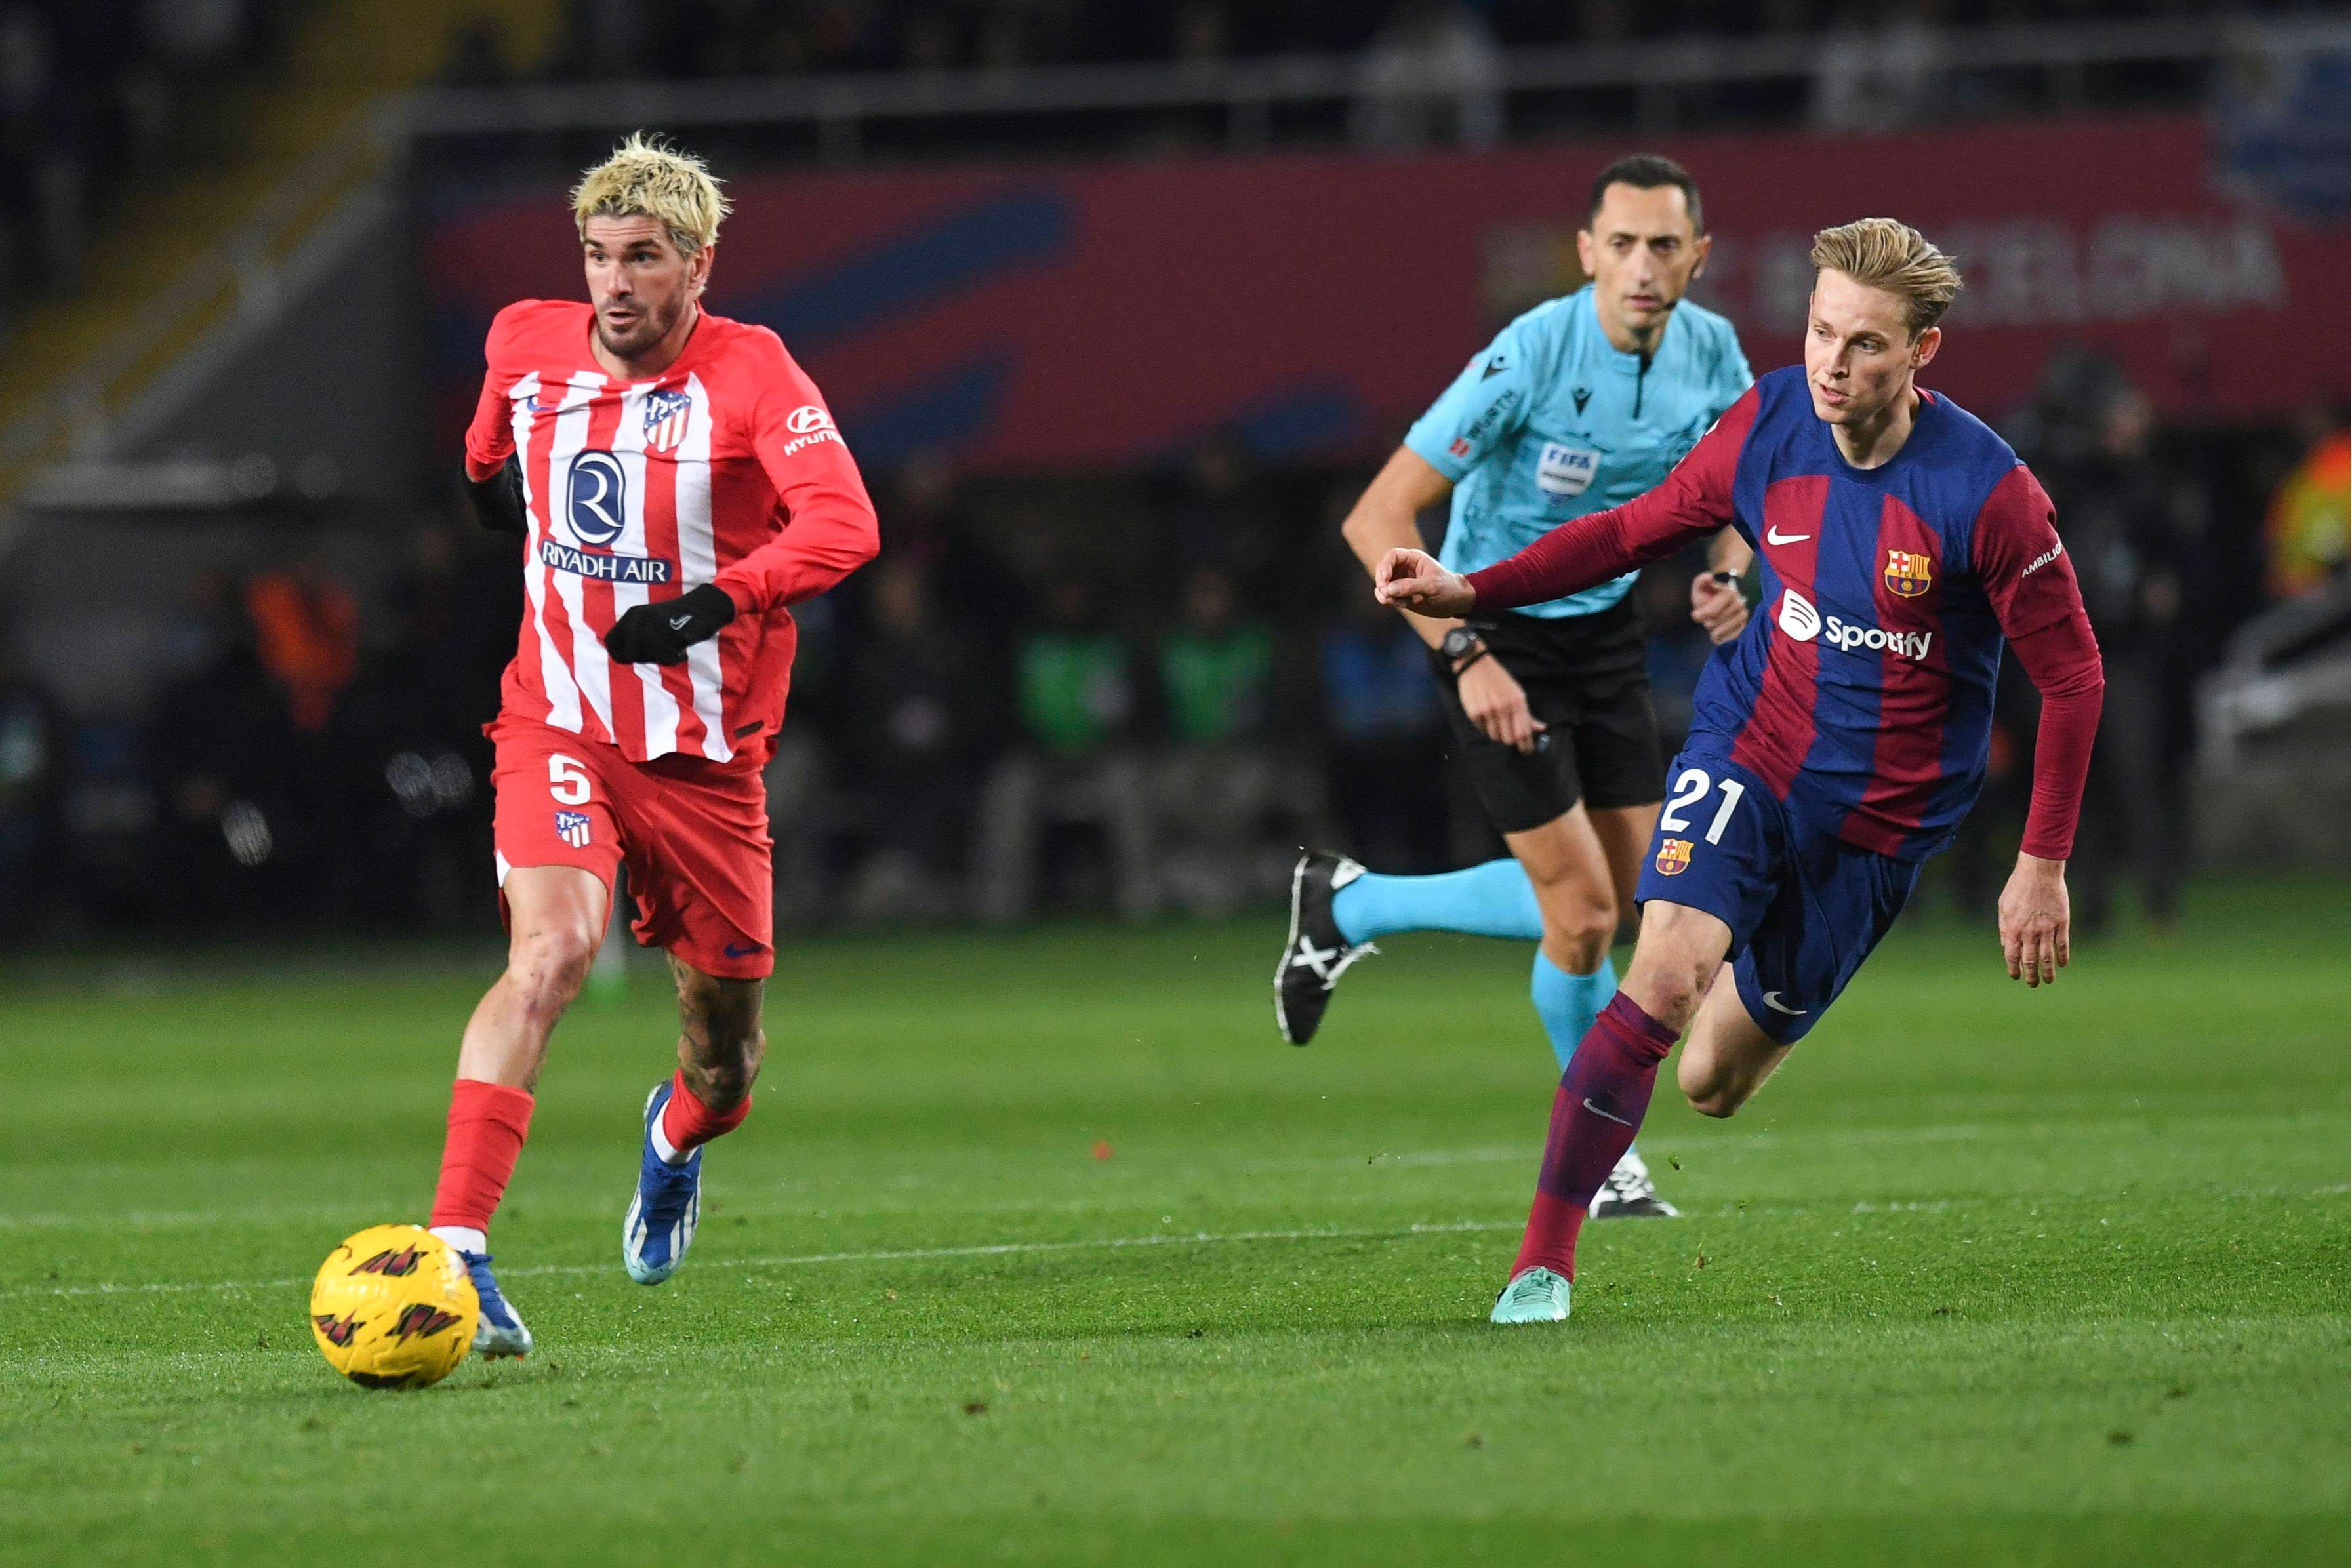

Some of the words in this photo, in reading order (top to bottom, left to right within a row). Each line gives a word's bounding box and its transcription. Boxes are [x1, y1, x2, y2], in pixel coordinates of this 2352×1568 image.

[784, 431, 847, 456] HYUN
[1549, 450, 1589, 469] FIFA
[542, 541, 617, 579] RIYADH
[624, 561, 666, 582] AIR
[2021, 542, 2062, 578] AMBILIG
[1825, 616, 1932, 660] Spotify
[548, 754, 591, 805] 5
[1660, 768, 1745, 845] 21
